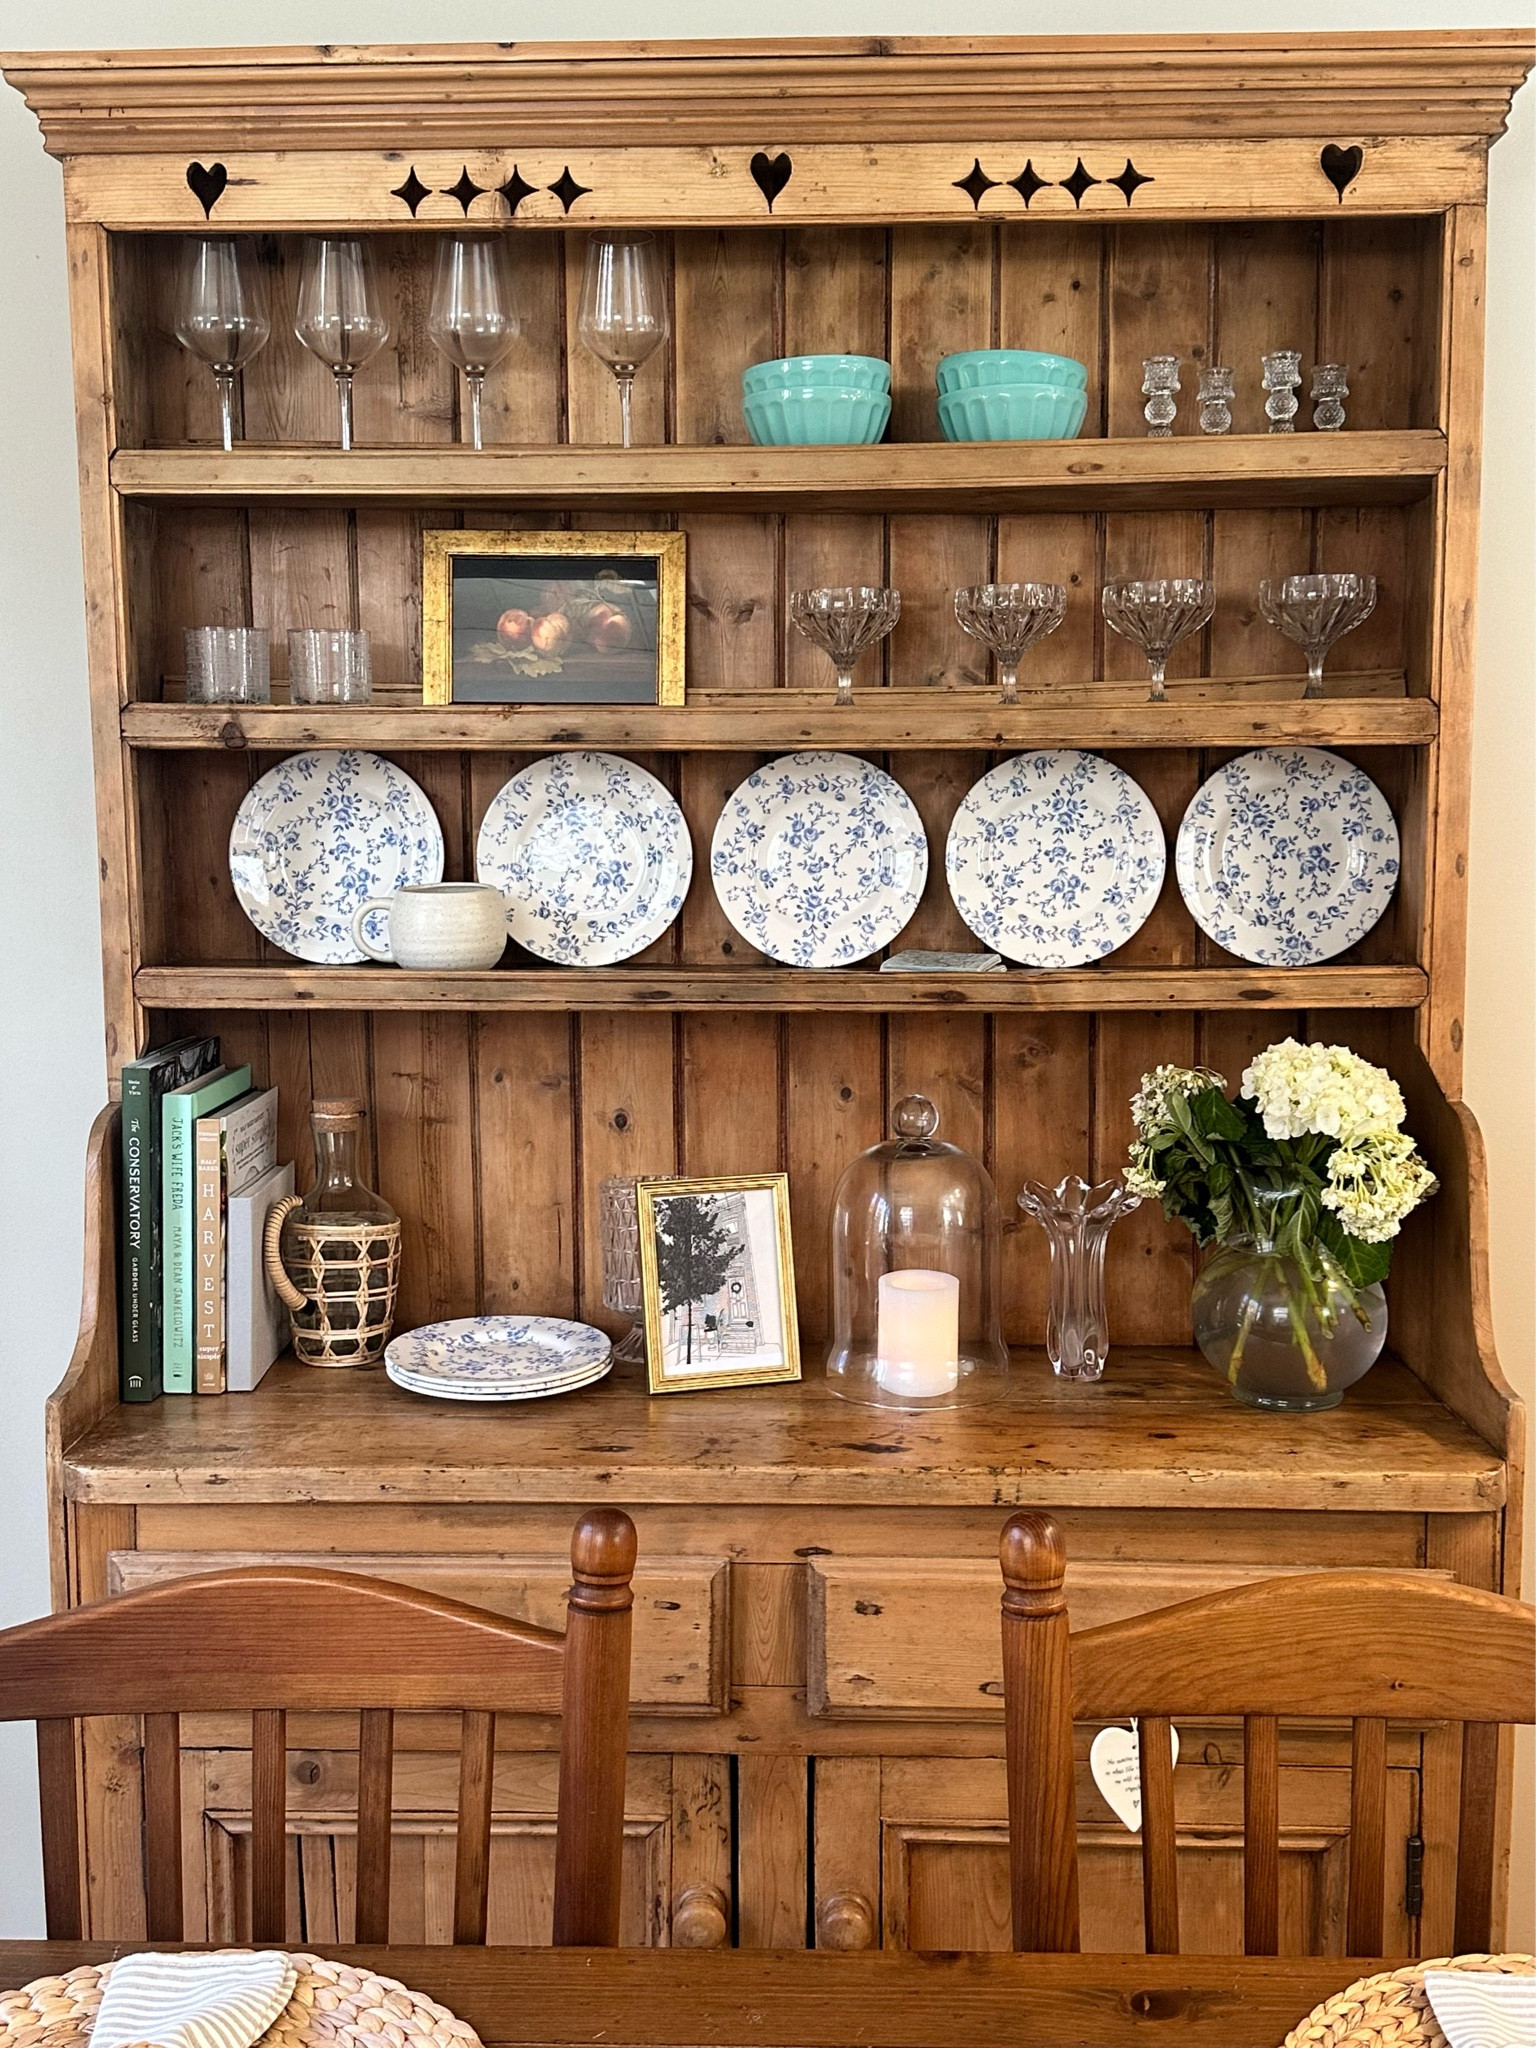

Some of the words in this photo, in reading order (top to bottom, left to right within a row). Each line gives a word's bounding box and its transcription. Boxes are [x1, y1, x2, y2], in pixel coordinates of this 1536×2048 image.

[130, 1119, 141, 1132] The
[172, 1117, 184, 1148] JACK'S
[171, 1151, 184, 1177] WIFE
[128, 1137, 141, 1249] CONSERVATORY
[172, 1181, 184, 1211] FREDA
[173, 1226, 182, 1249] MAYA
[173, 1261, 183, 1284] DEAN
[202, 1183, 215, 1338] HARVEST
[131, 1257, 139, 1291] GARDENS
[131, 1293, 139, 1319] UNDER
[173, 1288, 184, 1348] JANKELOWITZ
[131, 1320, 139, 1343] GLASS
[197, 1352, 221, 1360] simple
